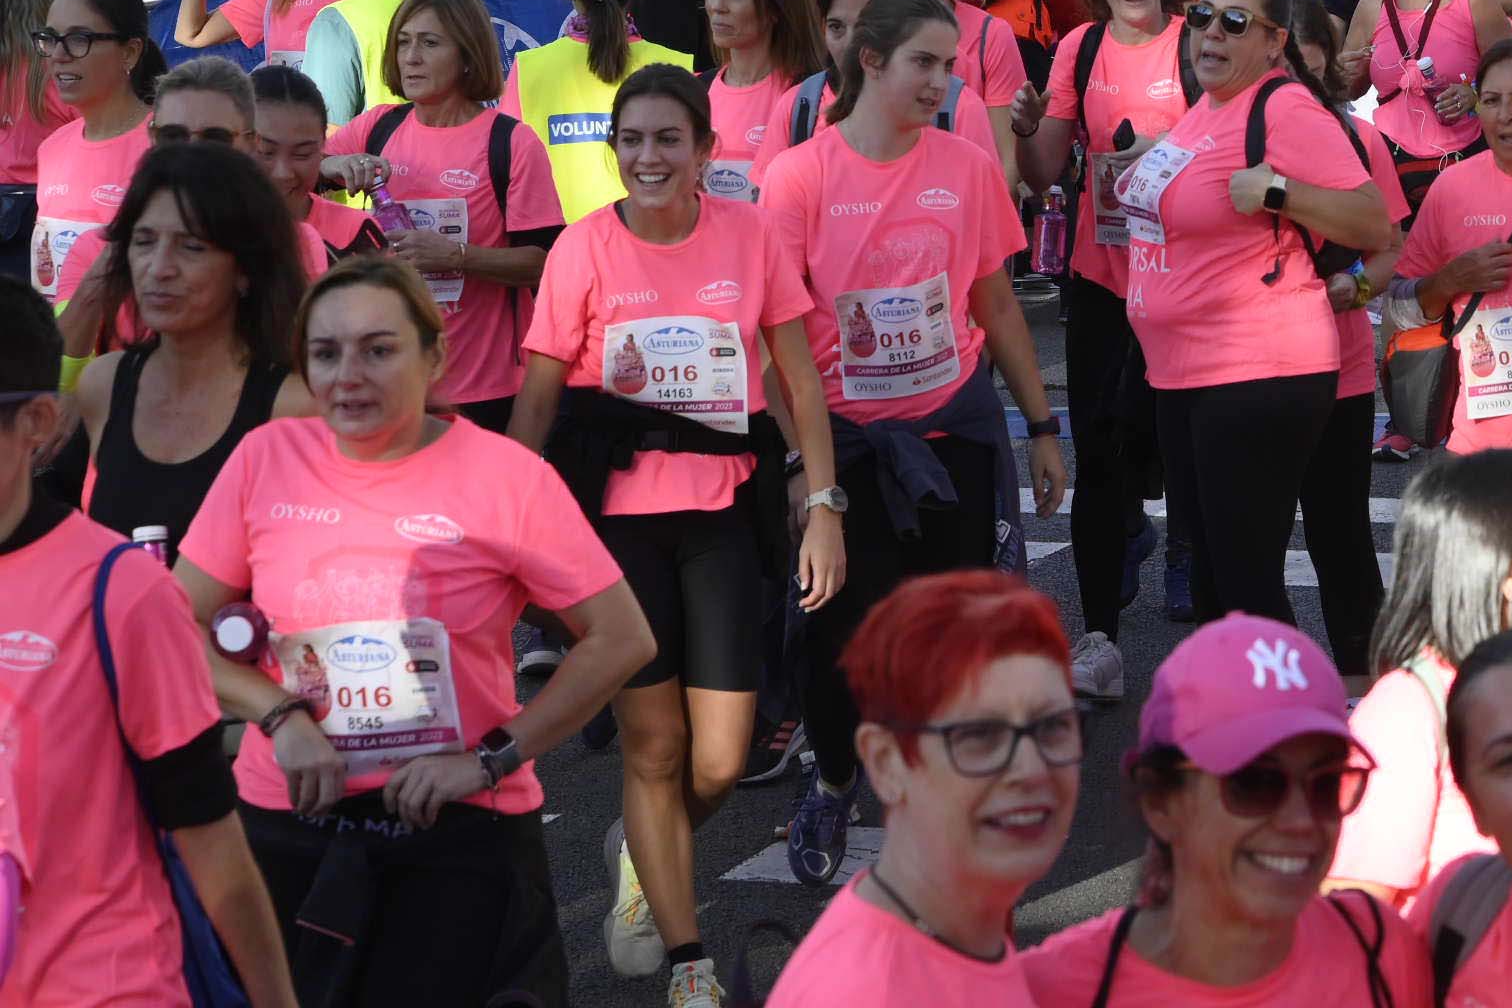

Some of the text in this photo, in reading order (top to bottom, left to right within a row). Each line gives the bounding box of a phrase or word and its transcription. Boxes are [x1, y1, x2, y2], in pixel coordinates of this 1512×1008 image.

[1130, 175, 1149, 192] 016
[831, 201, 883, 217] OYSHO
[1463, 214, 1507, 228] OYSHO
[606, 289, 659, 309] OYSHO
[875, 305, 920, 318] ASTURIANA
[649, 337, 700, 349] ASTURIANA
[879, 328, 922, 349] 016
[888, 350, 916, 362] 8112
[651, 364, 699, 383] 016
[856, 364, 889, 375] CARRERA
[889, 365, 901, 374] DE
[901, 364, 912, 373] LA
[912, 359, 935, 371] MUJER
[656, 387, 693, 399] 14163
[854, 381, 892, 393] OYSHO
[1478, 384, 1508, 394] CARRERA
[672, 403, 684, 411] LA
[684, 402, 713, 411] MUJER
[1476, 399, 1511, 411] OYSHO
[270, 503, 341, 525] OYSHO
[399, 521, 463, 541] ASTURIANA
[337, 686, 393, 708] 016
[347, 716, 385, 730] 8545
[348, 737, 362, 747] DE
[363, 737, 378, 747] LA
[379, 733, 416, 746] MUJER
